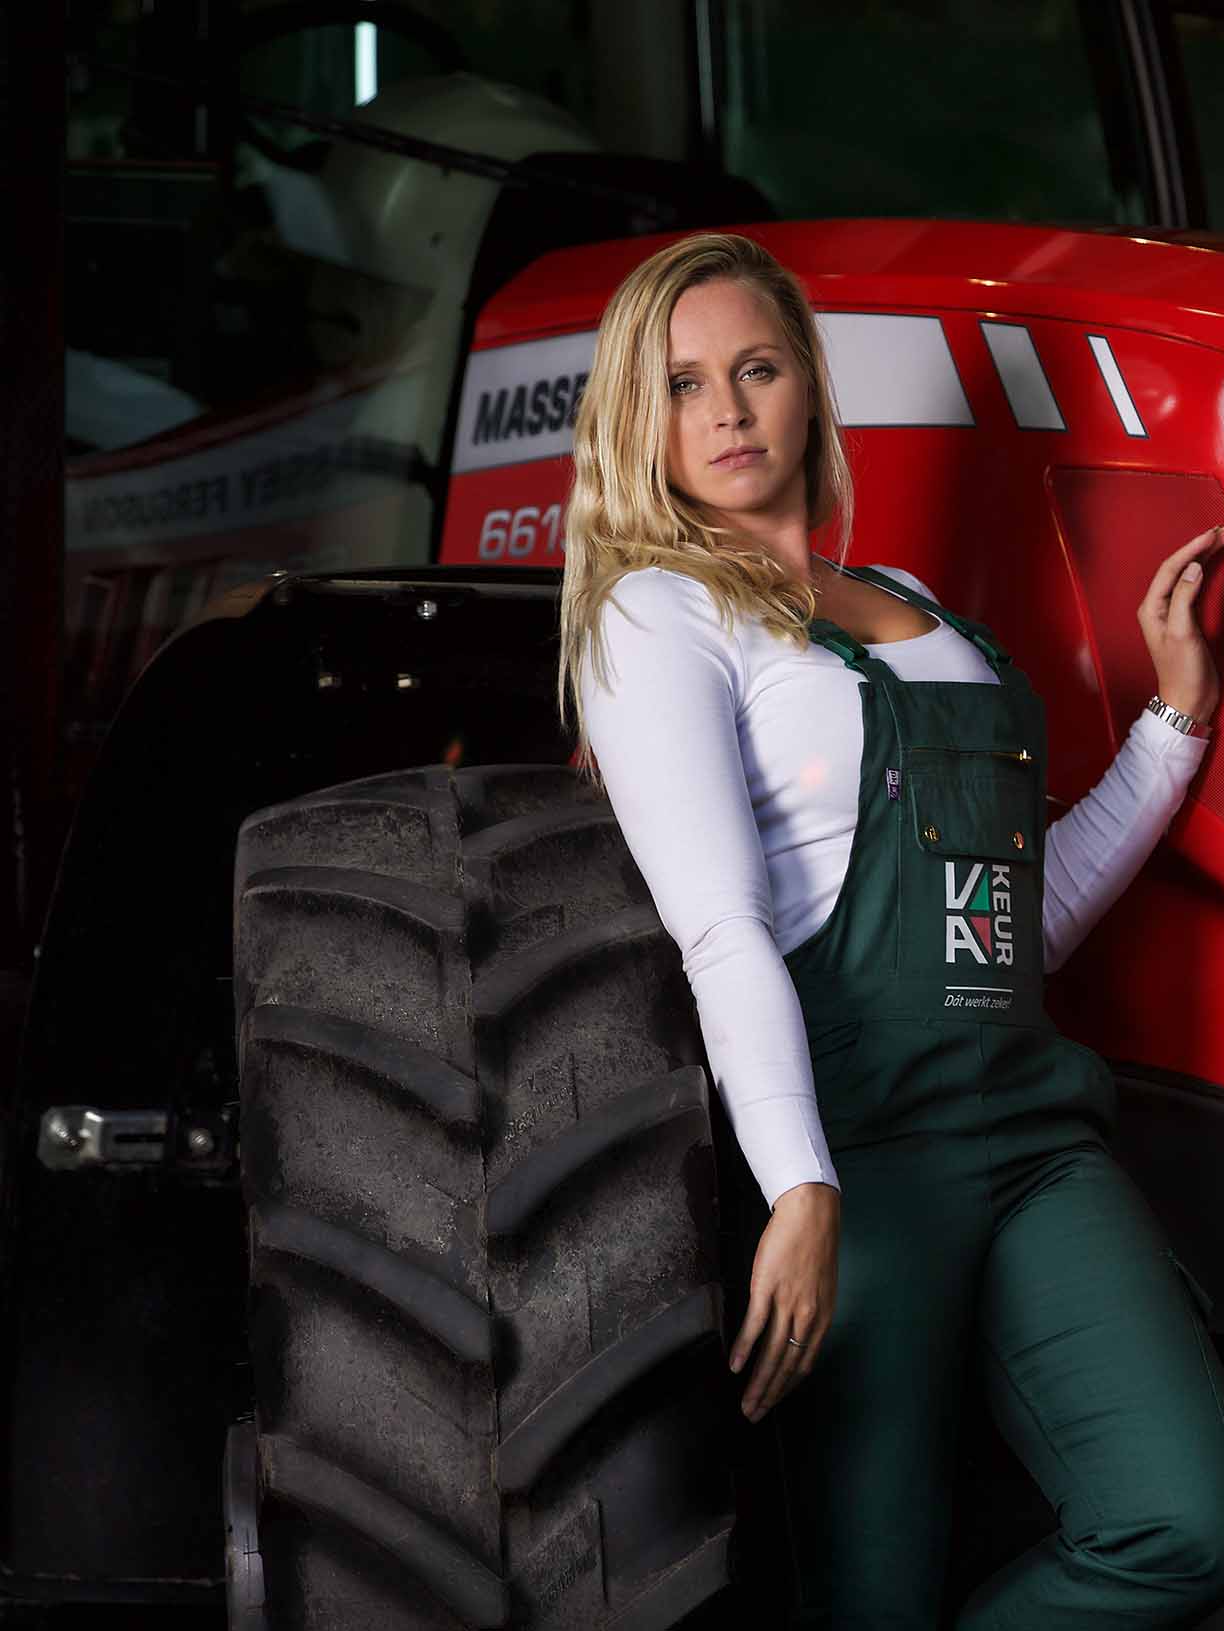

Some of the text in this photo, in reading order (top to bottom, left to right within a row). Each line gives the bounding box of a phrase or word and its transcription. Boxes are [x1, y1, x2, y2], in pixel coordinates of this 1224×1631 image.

[480, 504, 568, 560] 661
[992, 864, 1014, 966] KEUR
[965, 996, 990, 1008] werkt
